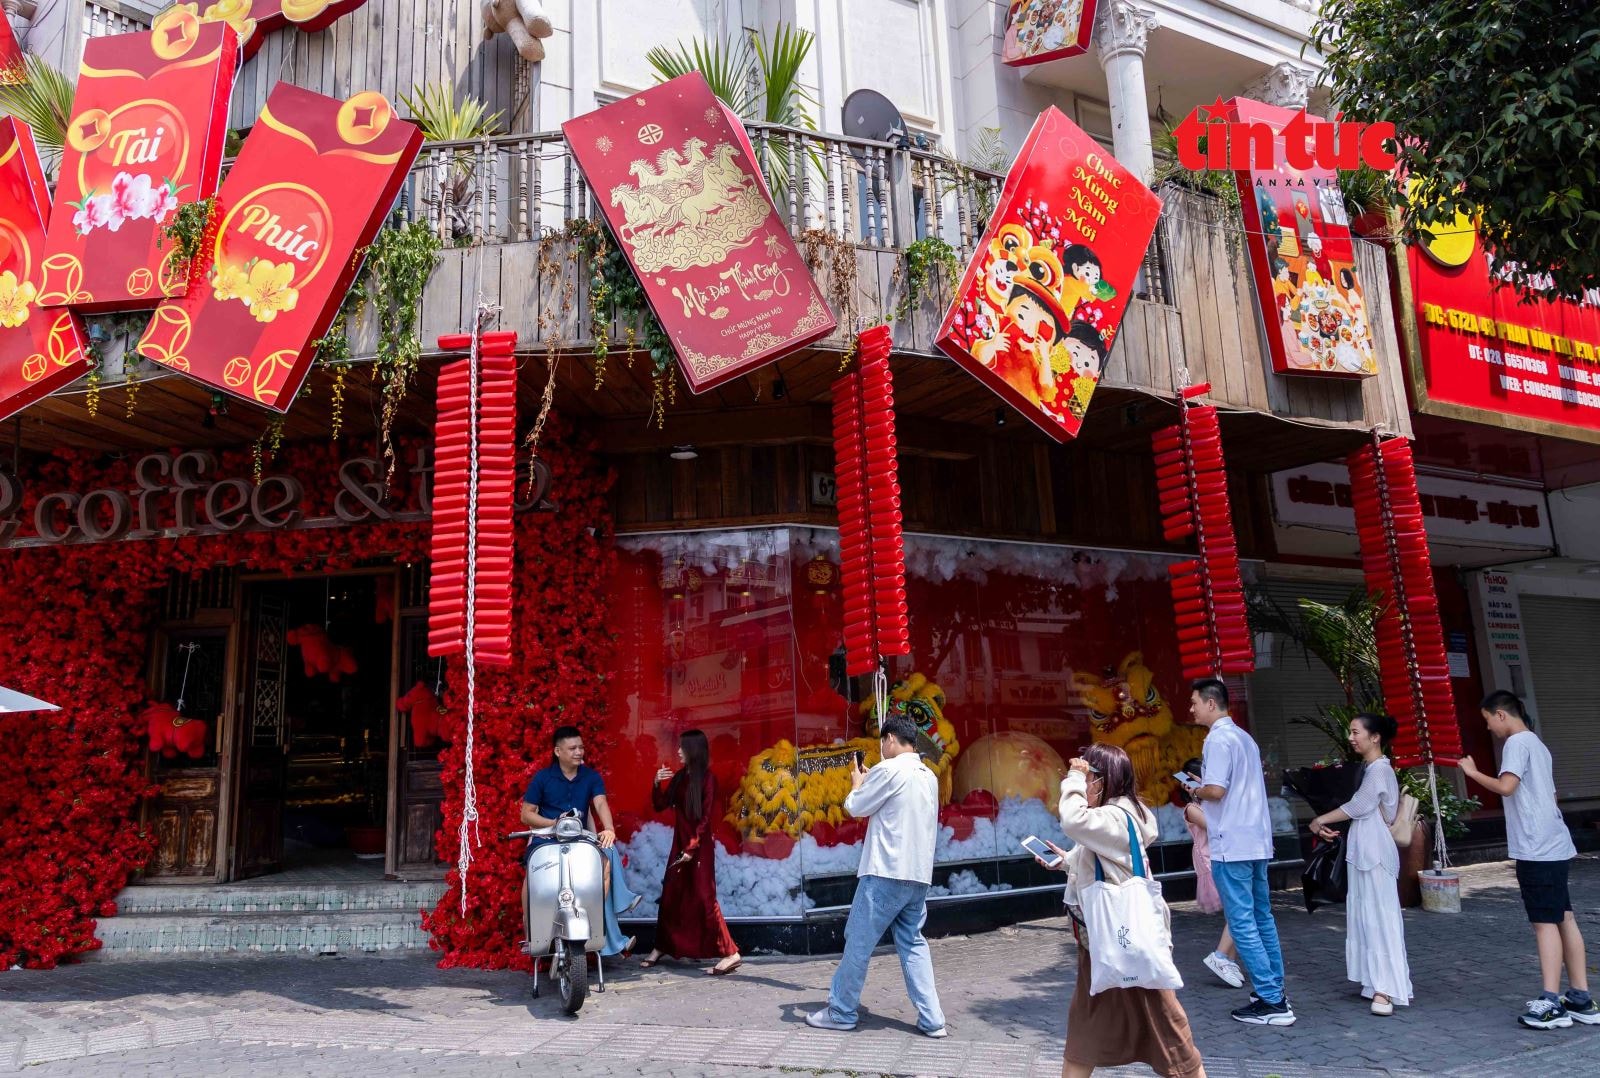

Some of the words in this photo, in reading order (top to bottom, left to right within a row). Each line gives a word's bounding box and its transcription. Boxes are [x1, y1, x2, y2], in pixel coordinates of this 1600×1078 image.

[109, 127, 164, 167] Tài
[1072, 166, 1119, 215] Mừng
[1086, 153, 1122, 189] Chúc
[1063, 208, 1097, 242] Mới
[1068, 186, 1107, 225] Năm
[236, 204, 319, 262] Phúc
[671, 282, 710, 319] Mã
[753, 261, 794, 297] Công
[738, 328, 757, 340] HAPPY
[756, 322, 774, 332] YEAR
[1497, 321, 1529, 347] PHAN
[35, 450, 303, 544] coffee
[336, 457, 394, 522] &
[407, 446, 560, 514] ta
